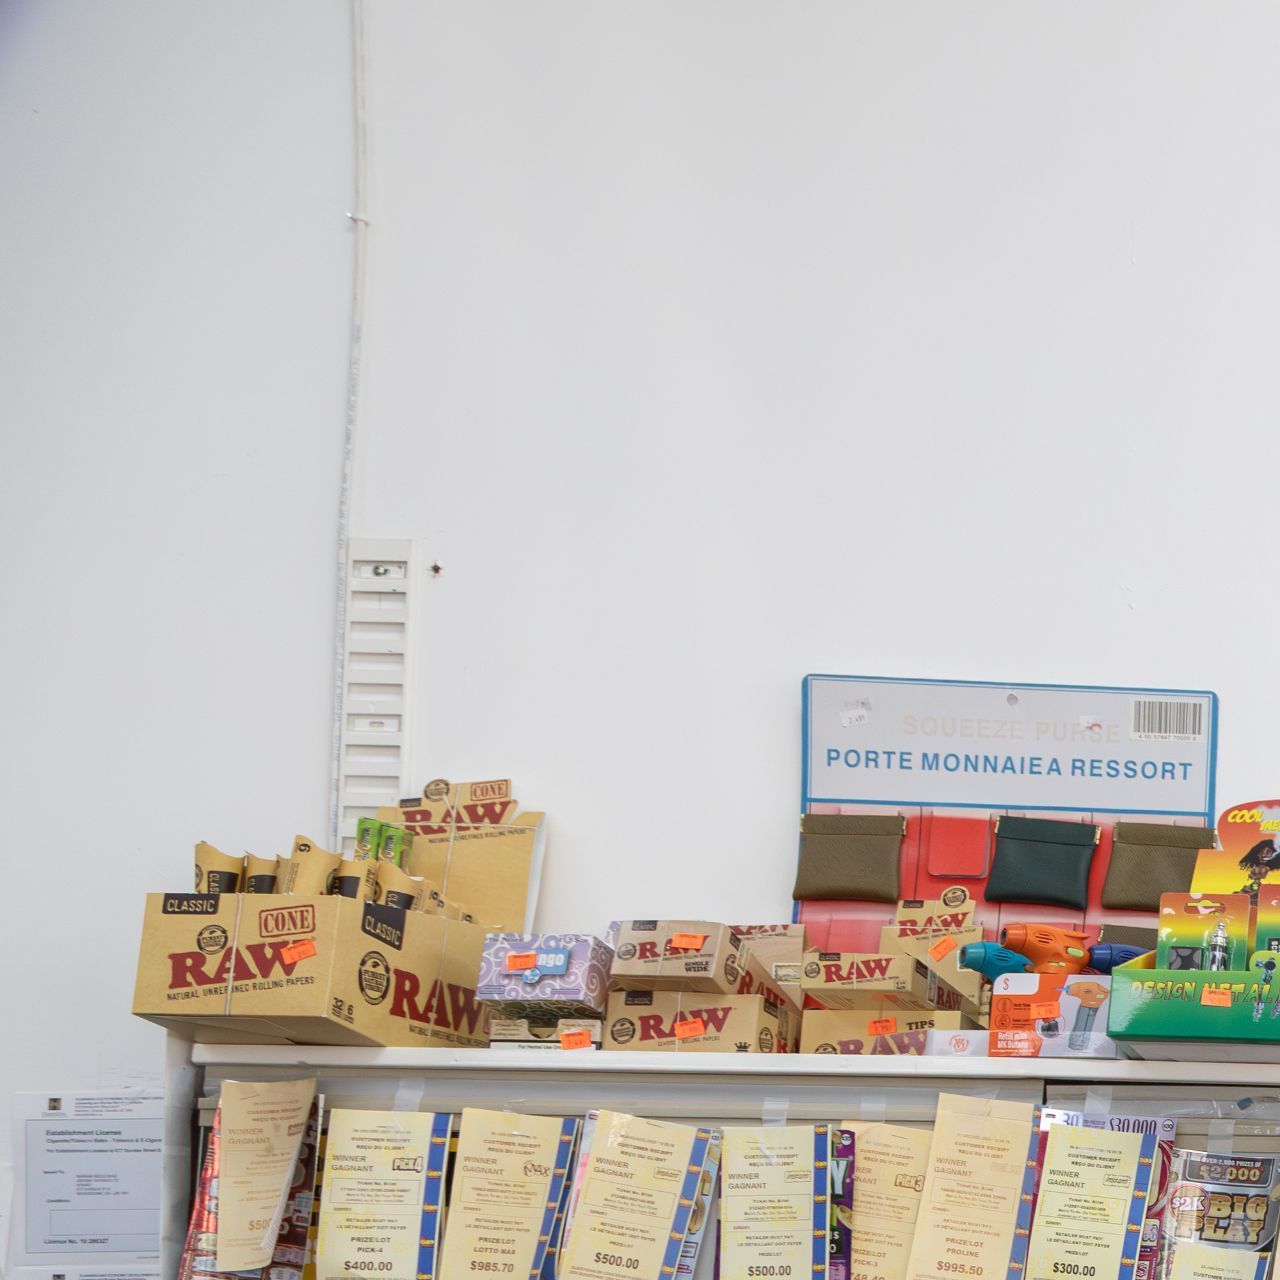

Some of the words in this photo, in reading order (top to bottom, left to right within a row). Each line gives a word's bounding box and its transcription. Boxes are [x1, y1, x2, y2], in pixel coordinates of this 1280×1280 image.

[904, 716, 1024, 740] SQUEEZE
[826, 748, 912, 770] PORTE
[1071, 759, 1192, 781] RESSORT
[167, 898, 215, 914] CLASSIC
[263, 907, 311, 934] CONE
[824, 958, 895, 982] RAW
[906, 1020, 935, 1031] TIPS
[344, 1260, 393, 1271] $400.00
[936, 1260, 983, 1276] $995.50
